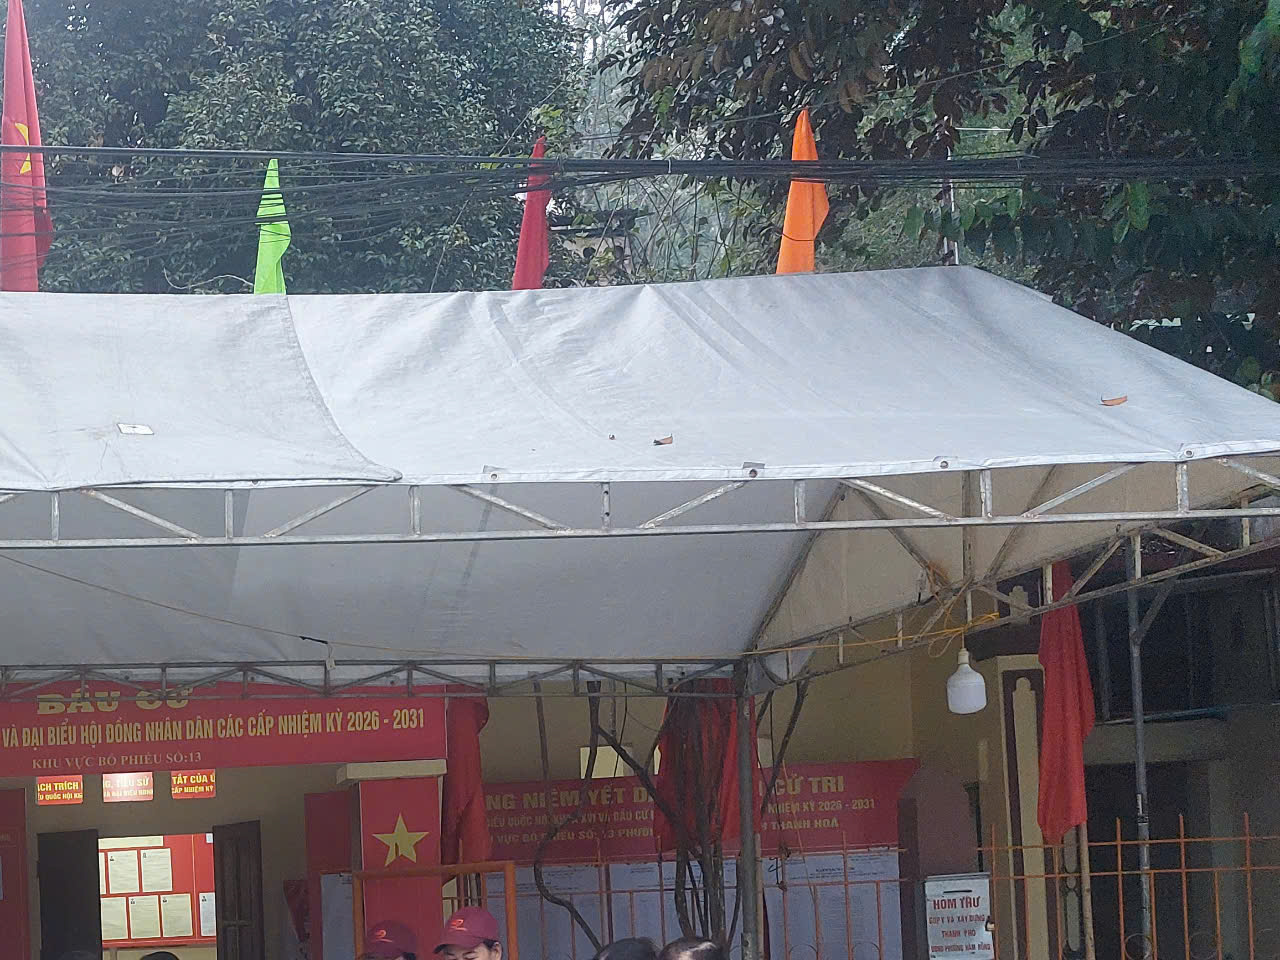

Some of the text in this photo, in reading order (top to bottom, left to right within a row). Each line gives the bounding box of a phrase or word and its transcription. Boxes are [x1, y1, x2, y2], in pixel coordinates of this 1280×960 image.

[2, 724, 19, 748] VÀ
[22, 727, 44, 751] ĐẠI
[48, 718, 77, 746] BIỂU
[81, 720, 102, 748] HỘI
[105, 717, 142, 744] ĐỒNG
[145, 717, 182, 742] NHÂN
[186, 716, 214, 740] DÂN
[217, 713, 244, 738] CÁC
[247, 708, 275, 737] CẤP
[278, 709, 322, 738] NHIỆM
[326, 708, 343, 733] KỲ
[347, 710, 380, 732] 2026
[392, 708, 425, 729] 2031
[32, 757, 62, 770] KHU
[64, 755, 95, 771] VỰC
[190, 772, 208, 784] CỦA
[807, 775, 844, 794] TRI
[53, 780, 79, 791] TRÍCH
[851, 798, 875, 810] 2031
